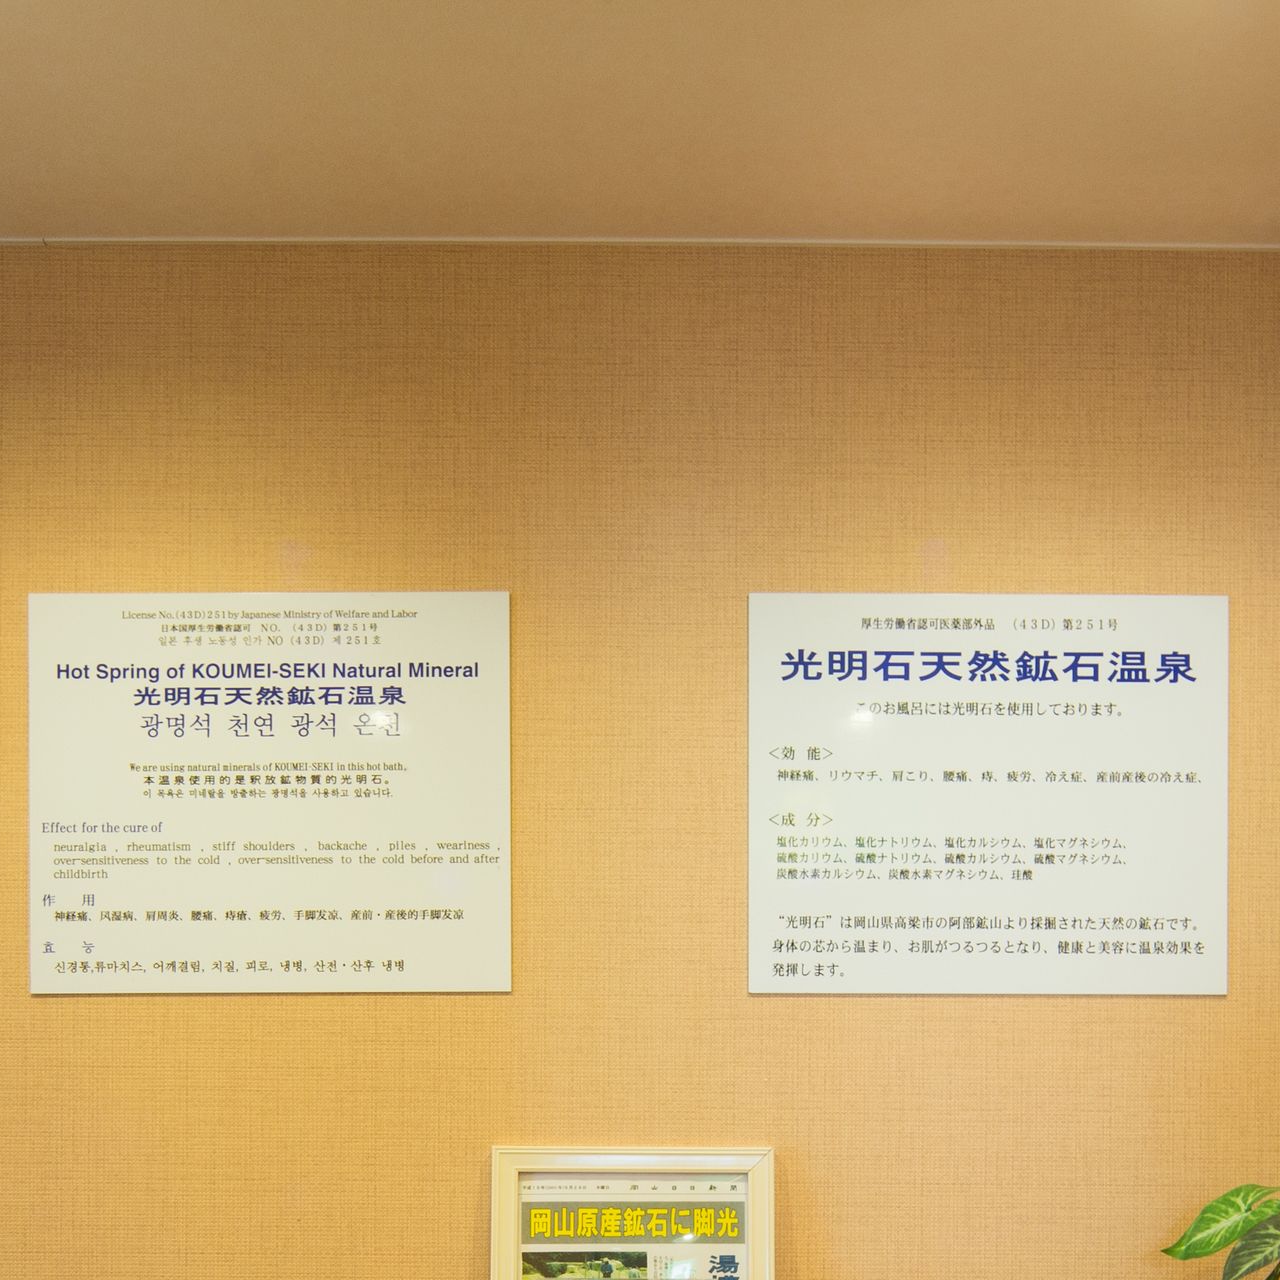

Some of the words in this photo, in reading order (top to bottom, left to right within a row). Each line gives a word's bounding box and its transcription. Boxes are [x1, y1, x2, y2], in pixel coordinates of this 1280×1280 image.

[122, 610, 156, 619] License
[240, 610, 281, 621] Japanese
[283, 609, 321, 620] Ministry
[323, 609, 334, 619] of
[335, 609, 370, 619] Welfare
[372, 609, 390, 619] and
[391, 609, 418, 619] Labor
[861, 617, 995, 631] 厚生労働省認可医薬部外品
[56, 664, 90, 679] Hot
[96, 663, 160, 683] Spring
[166, 663, 185, 679] of
[192, 663, 326, 678] KOUMEI-SEKI
[333, 662, 402, 678] Natural
[409, 662, 479, 678] Mineral
[780, 648, 1198, 683] 光明石天然鉱石温泉
[133, 686, 406, 706] 光明石天然鉱石温泉
[856, 701, 1123, 717] このお風呂には光明石を使用しております。
[140, 713, 211, 738] 광명석
[228, 713, 275, 738] 천연
[291, 712, 336, 738] 광석
[142, 764, 158, 772] are
[160, 763, 185, 774] using
[187, 762, 220, 772] natural
[223, 762, 260, 772] minerals
[263, 762, 273, 772] of
[274, 762, 334, 772] KOUMEI-SEKI
[337, 762, 346, 772] in
[347, 762, 365, 772] this
[366, 762, 381, 772] hot
[41, 822, 77, 833] Effect
[82, 822, 98, 833] for
[101, 822, 120, 833] the
[123, 823, 148, 833] cure
[151, 821, 163, 833] of
[53, 842, 107, 853] neuralgia
[127, 841, 191, 851] rheumatism
[212, 841, 236, 851] stiff
[243, 840, 295, 851] shoulders
[318, 840, 368, 851] backache
[389, 840, 416, 852] piles
[437, 840, 490, 850] weariness
[156, 856, 167, 865] to
[174, 855, 191, 865] the
[198, 855, 220, 865] cold
[341, 855, 352, 864] to
[359, 854, 376, 864] the
[382, 854, 405, 864] cold
[410, 854, 443, 864] before
[449, 854, 469, 864] and
[474, 854, 500, 864] after
[53, 869, 108, 879] childbirth
[772, 962, 845, 978] 発揮します。
[529, 1206, 739, 1239] 岡山原産鉱石に脚光
